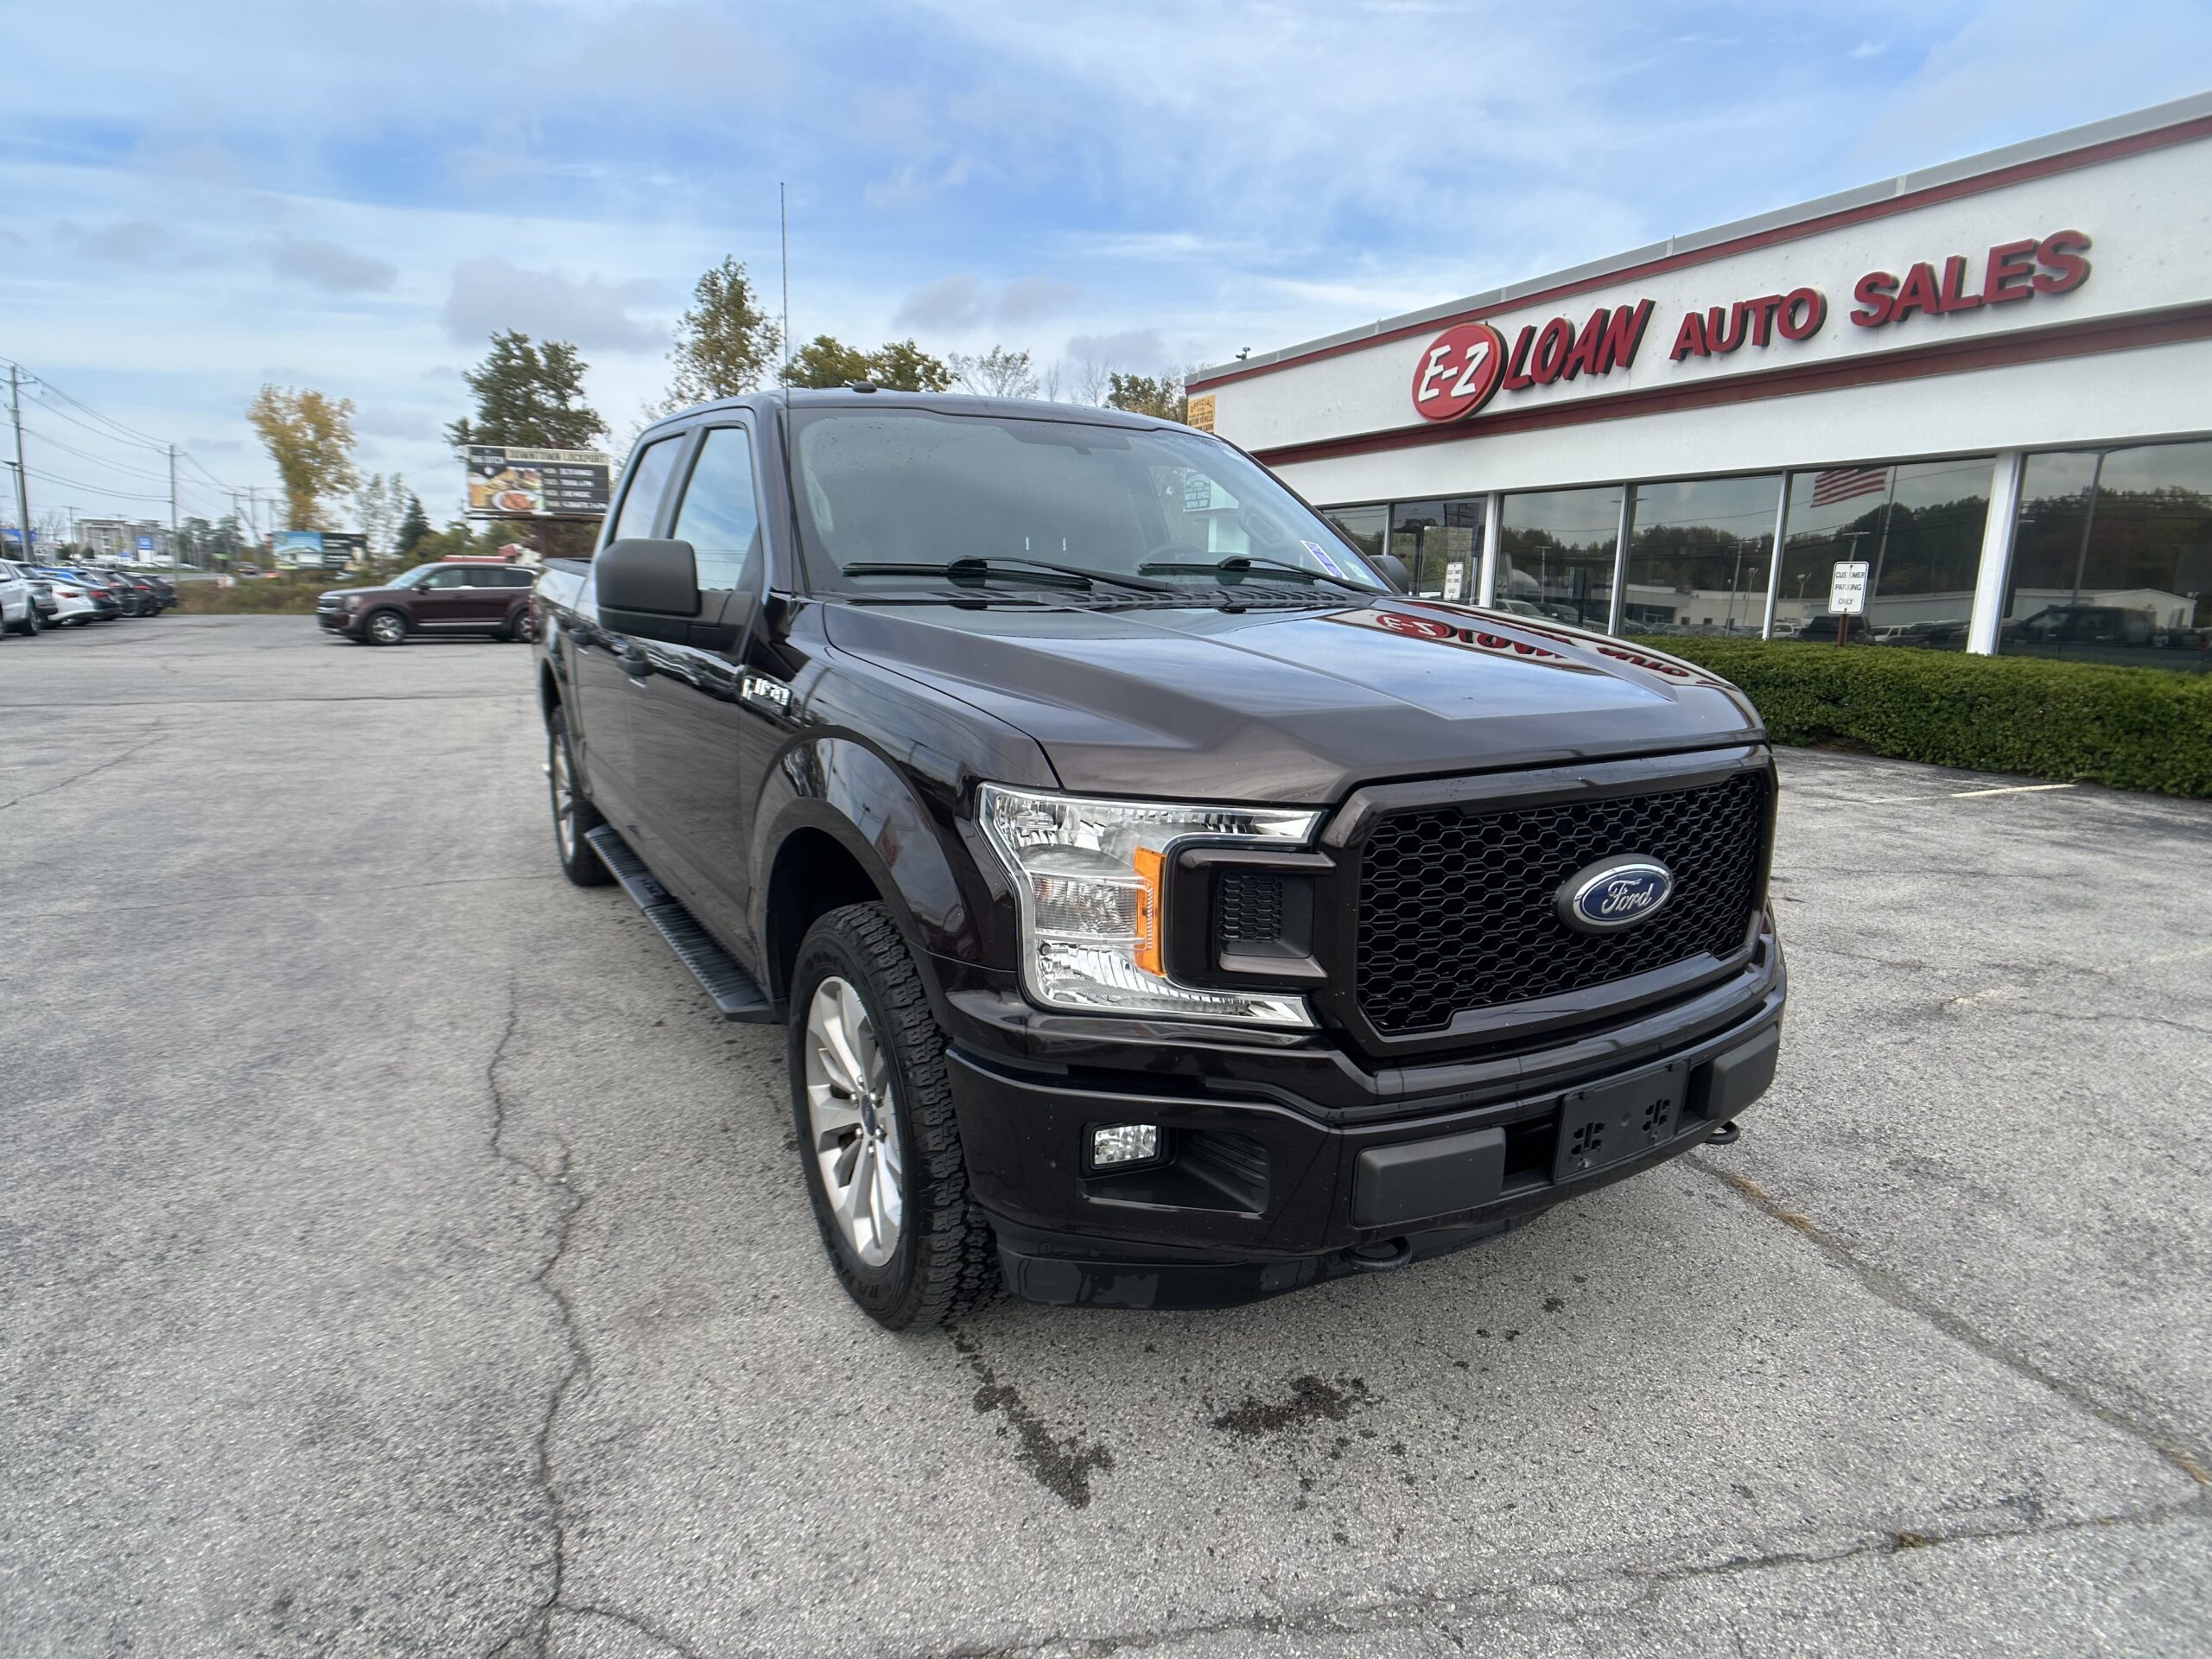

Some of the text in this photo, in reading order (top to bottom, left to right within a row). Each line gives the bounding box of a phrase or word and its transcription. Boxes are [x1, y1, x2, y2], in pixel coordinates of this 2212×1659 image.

[1416, 230, 2092, 403] E-Z LOAN AUTO SALES
[1601, 878, 1655, 914] Ford
